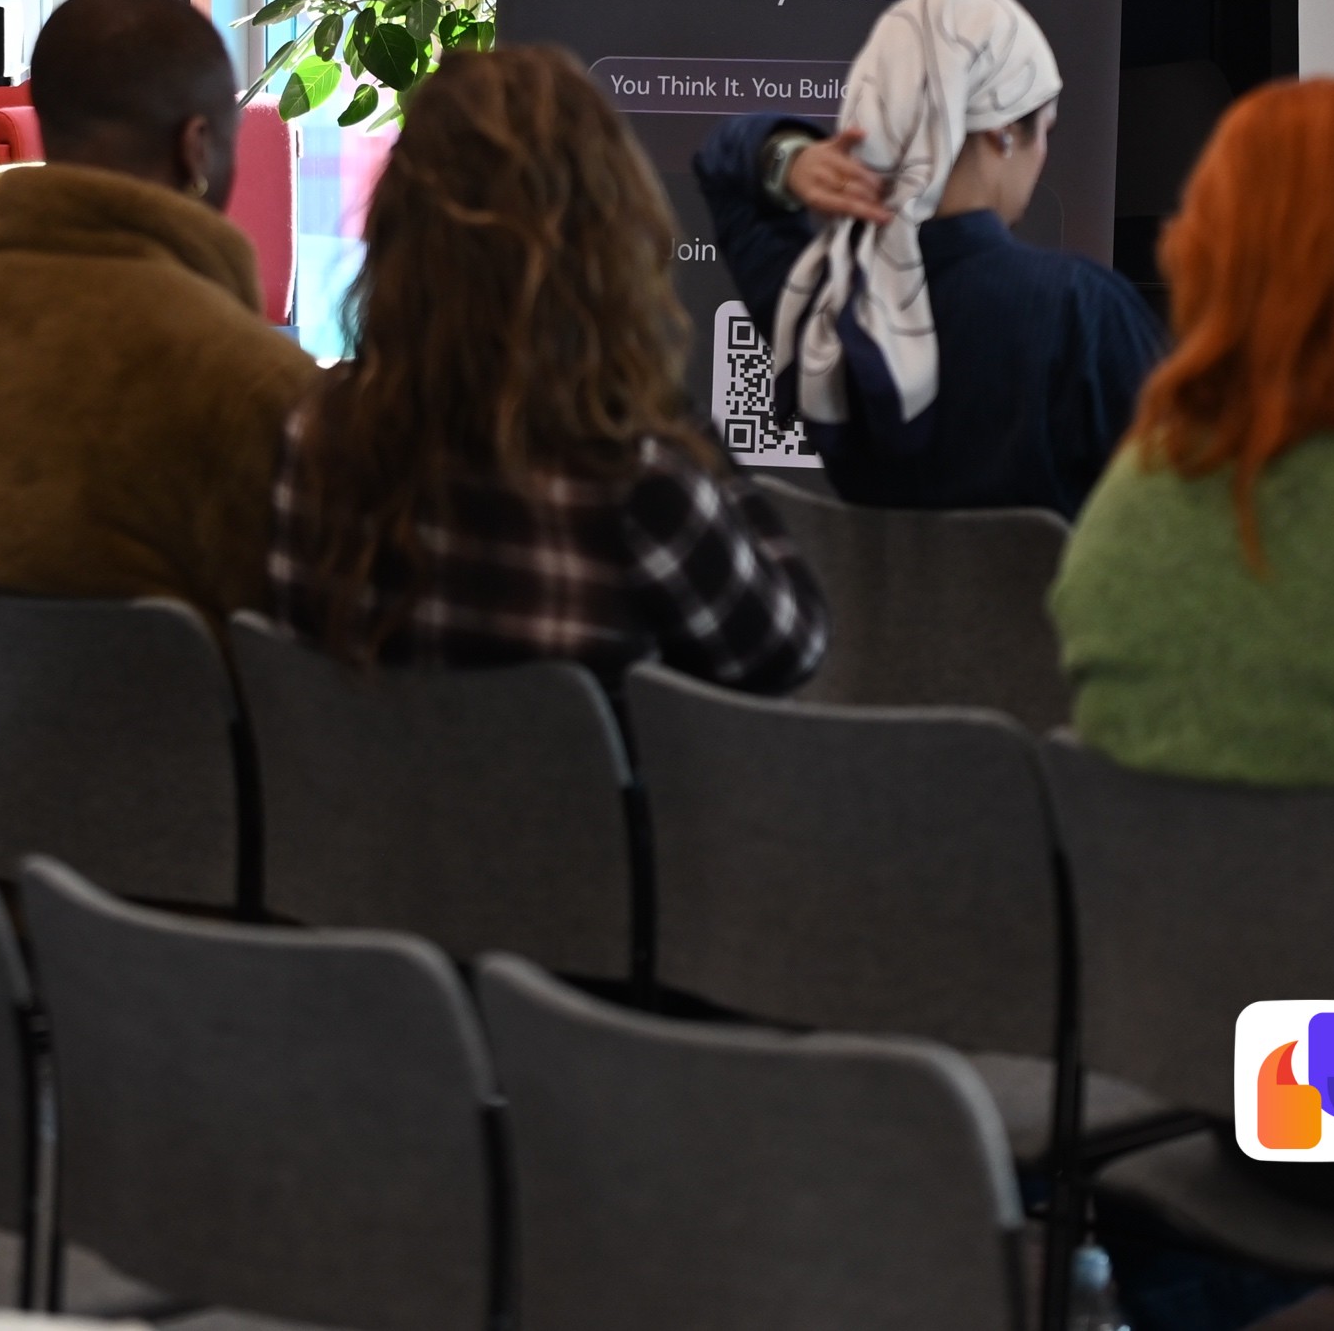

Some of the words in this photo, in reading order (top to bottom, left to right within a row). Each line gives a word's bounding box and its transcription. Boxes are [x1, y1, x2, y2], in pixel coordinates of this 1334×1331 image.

[610, 74, 651, 98] You
[657, 74, 717, 97] Think
[725, 77, 745, 97] It.
[752, 77, 792, 98] You
